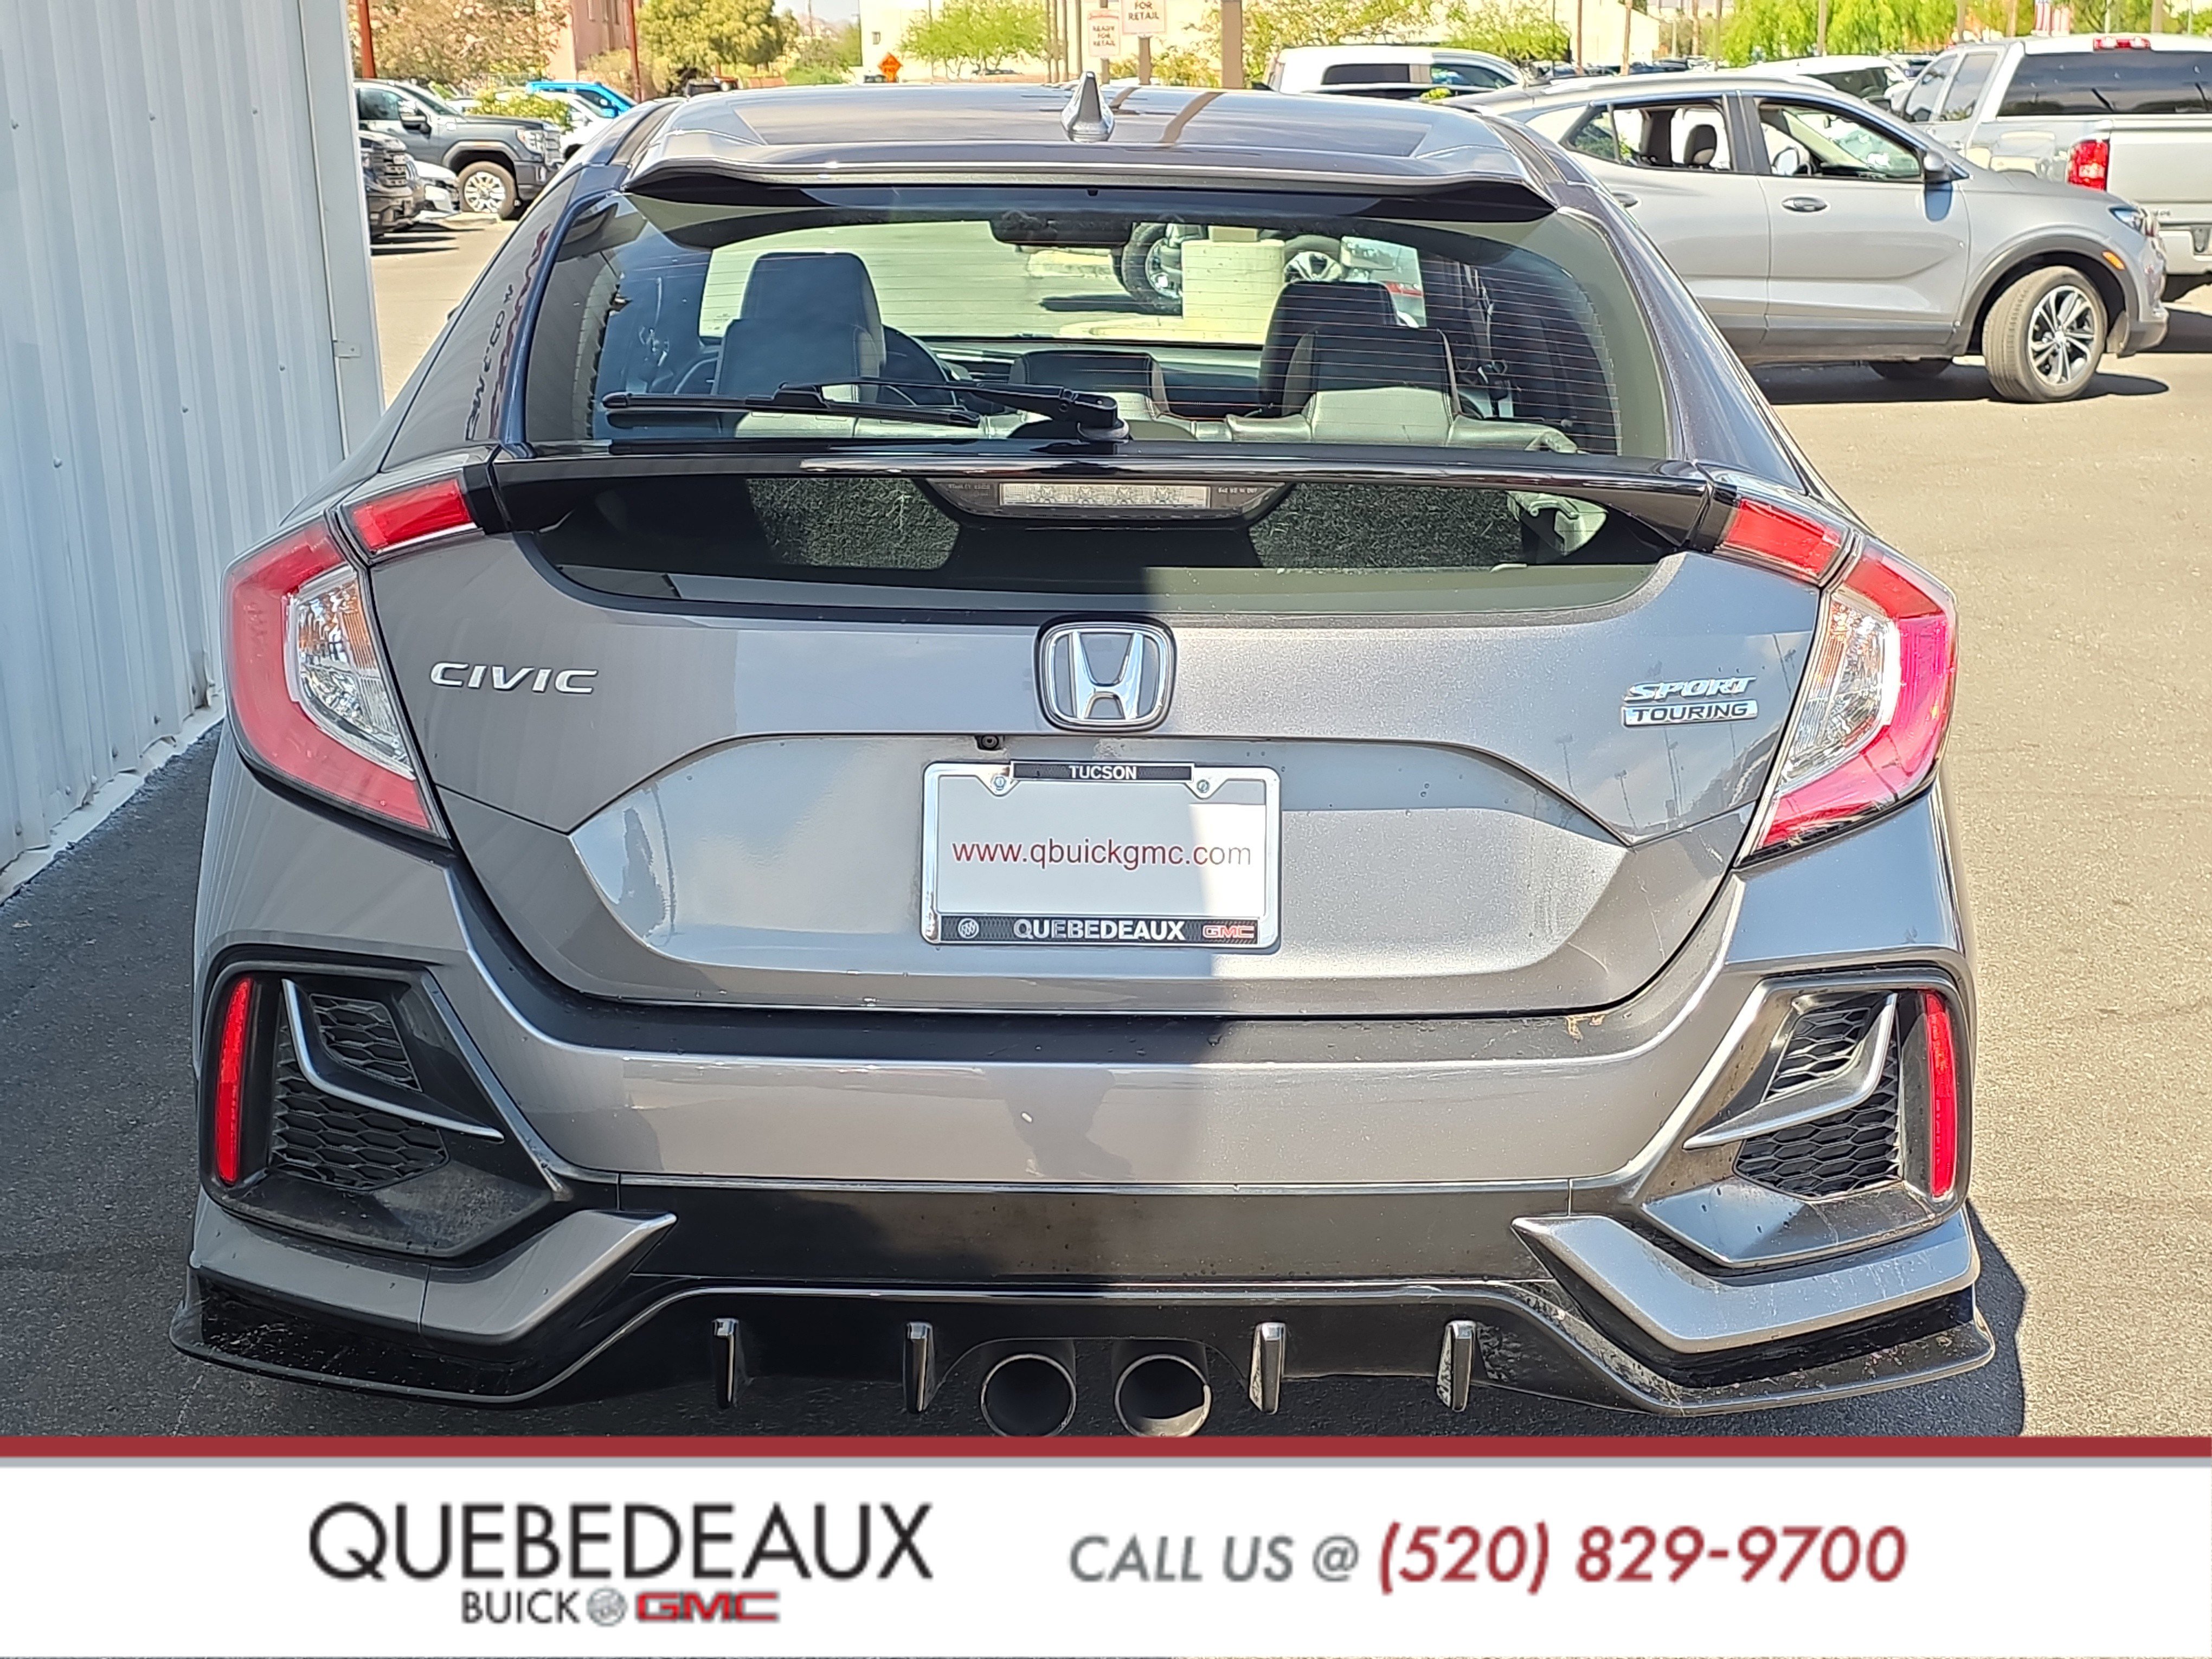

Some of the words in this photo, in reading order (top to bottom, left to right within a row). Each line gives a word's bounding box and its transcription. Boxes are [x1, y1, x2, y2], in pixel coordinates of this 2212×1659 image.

[1128, 11, 1159, 21] RETAIL
[1134, 1, 1153, 9] FOR
[430, 661, 598, 694] CIVIC
[1623, 676, 1757, 701] SPORT
[1632, 702, 1749, 722] TOURING
[1069, 765, 1137, 780] TUCSON
[952, 839, 1251, 870] www.qbuickgmc.com
[1012, 918, 1186, 942] QUEBEDEAUX
[1202, 925, 1256, 940] GMC
